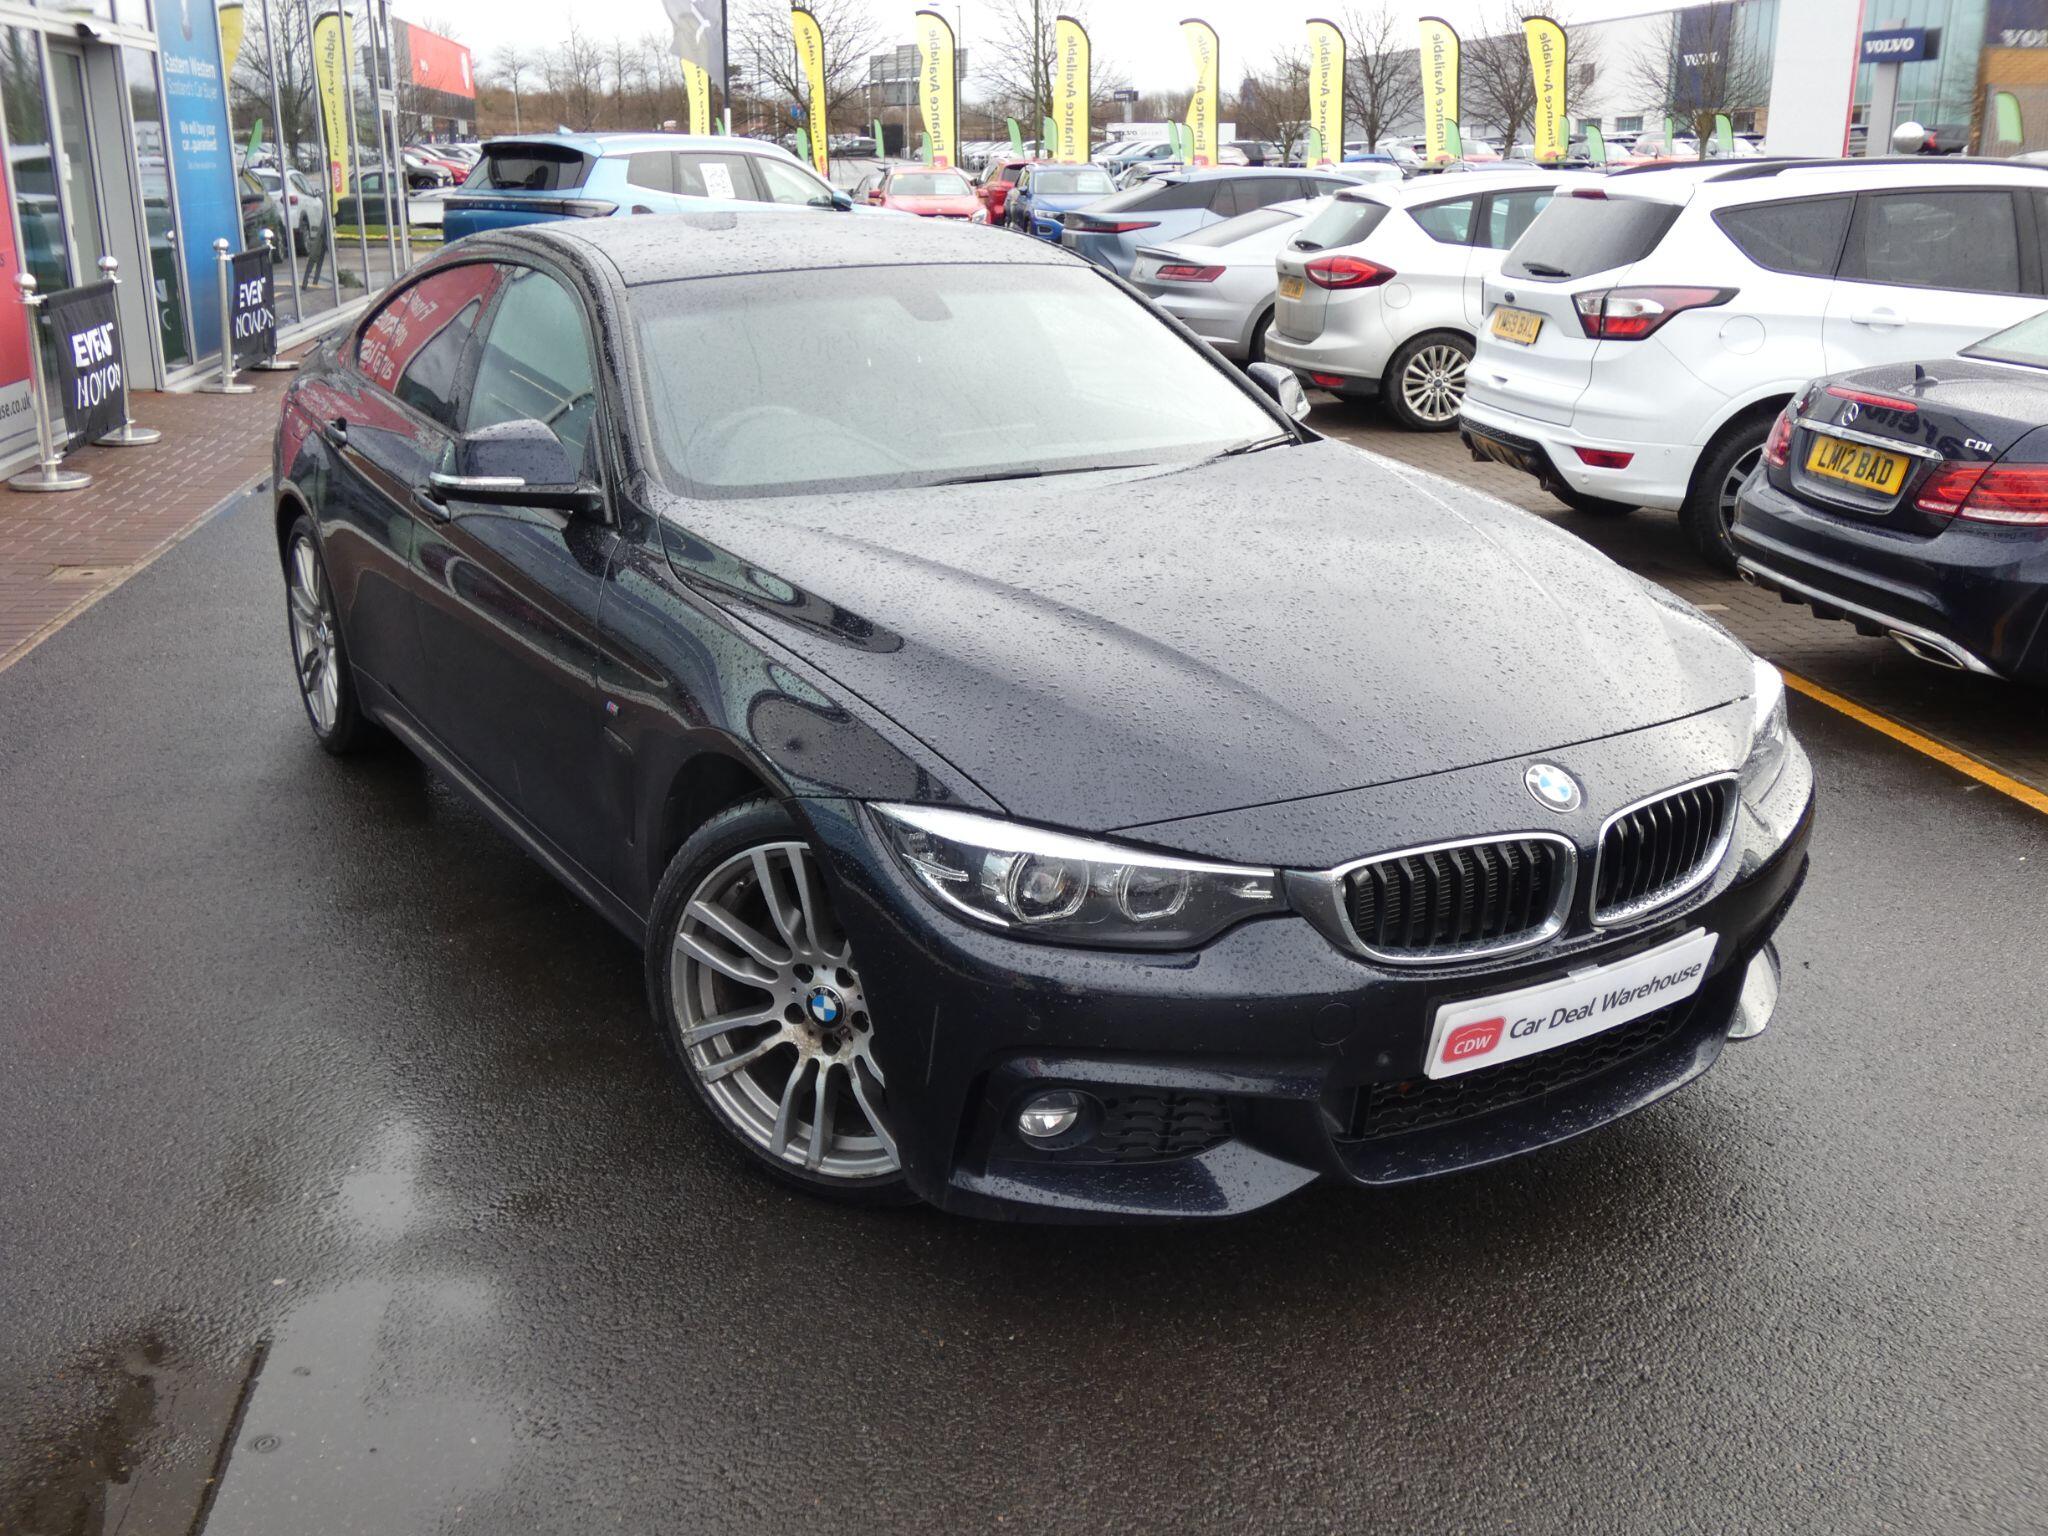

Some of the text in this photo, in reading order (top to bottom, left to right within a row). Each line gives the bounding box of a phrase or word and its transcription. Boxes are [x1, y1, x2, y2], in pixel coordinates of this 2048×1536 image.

[1864, 37, 1916, 53] VOLVO
[1963, 437, 1994, 453] CDI
[1817, 438, 1895, 486] LM12 BAD
[1509, 961, 1703, 1040] Car Deal Warehouse
[1453, 1033, 1493, 1056] CDW
